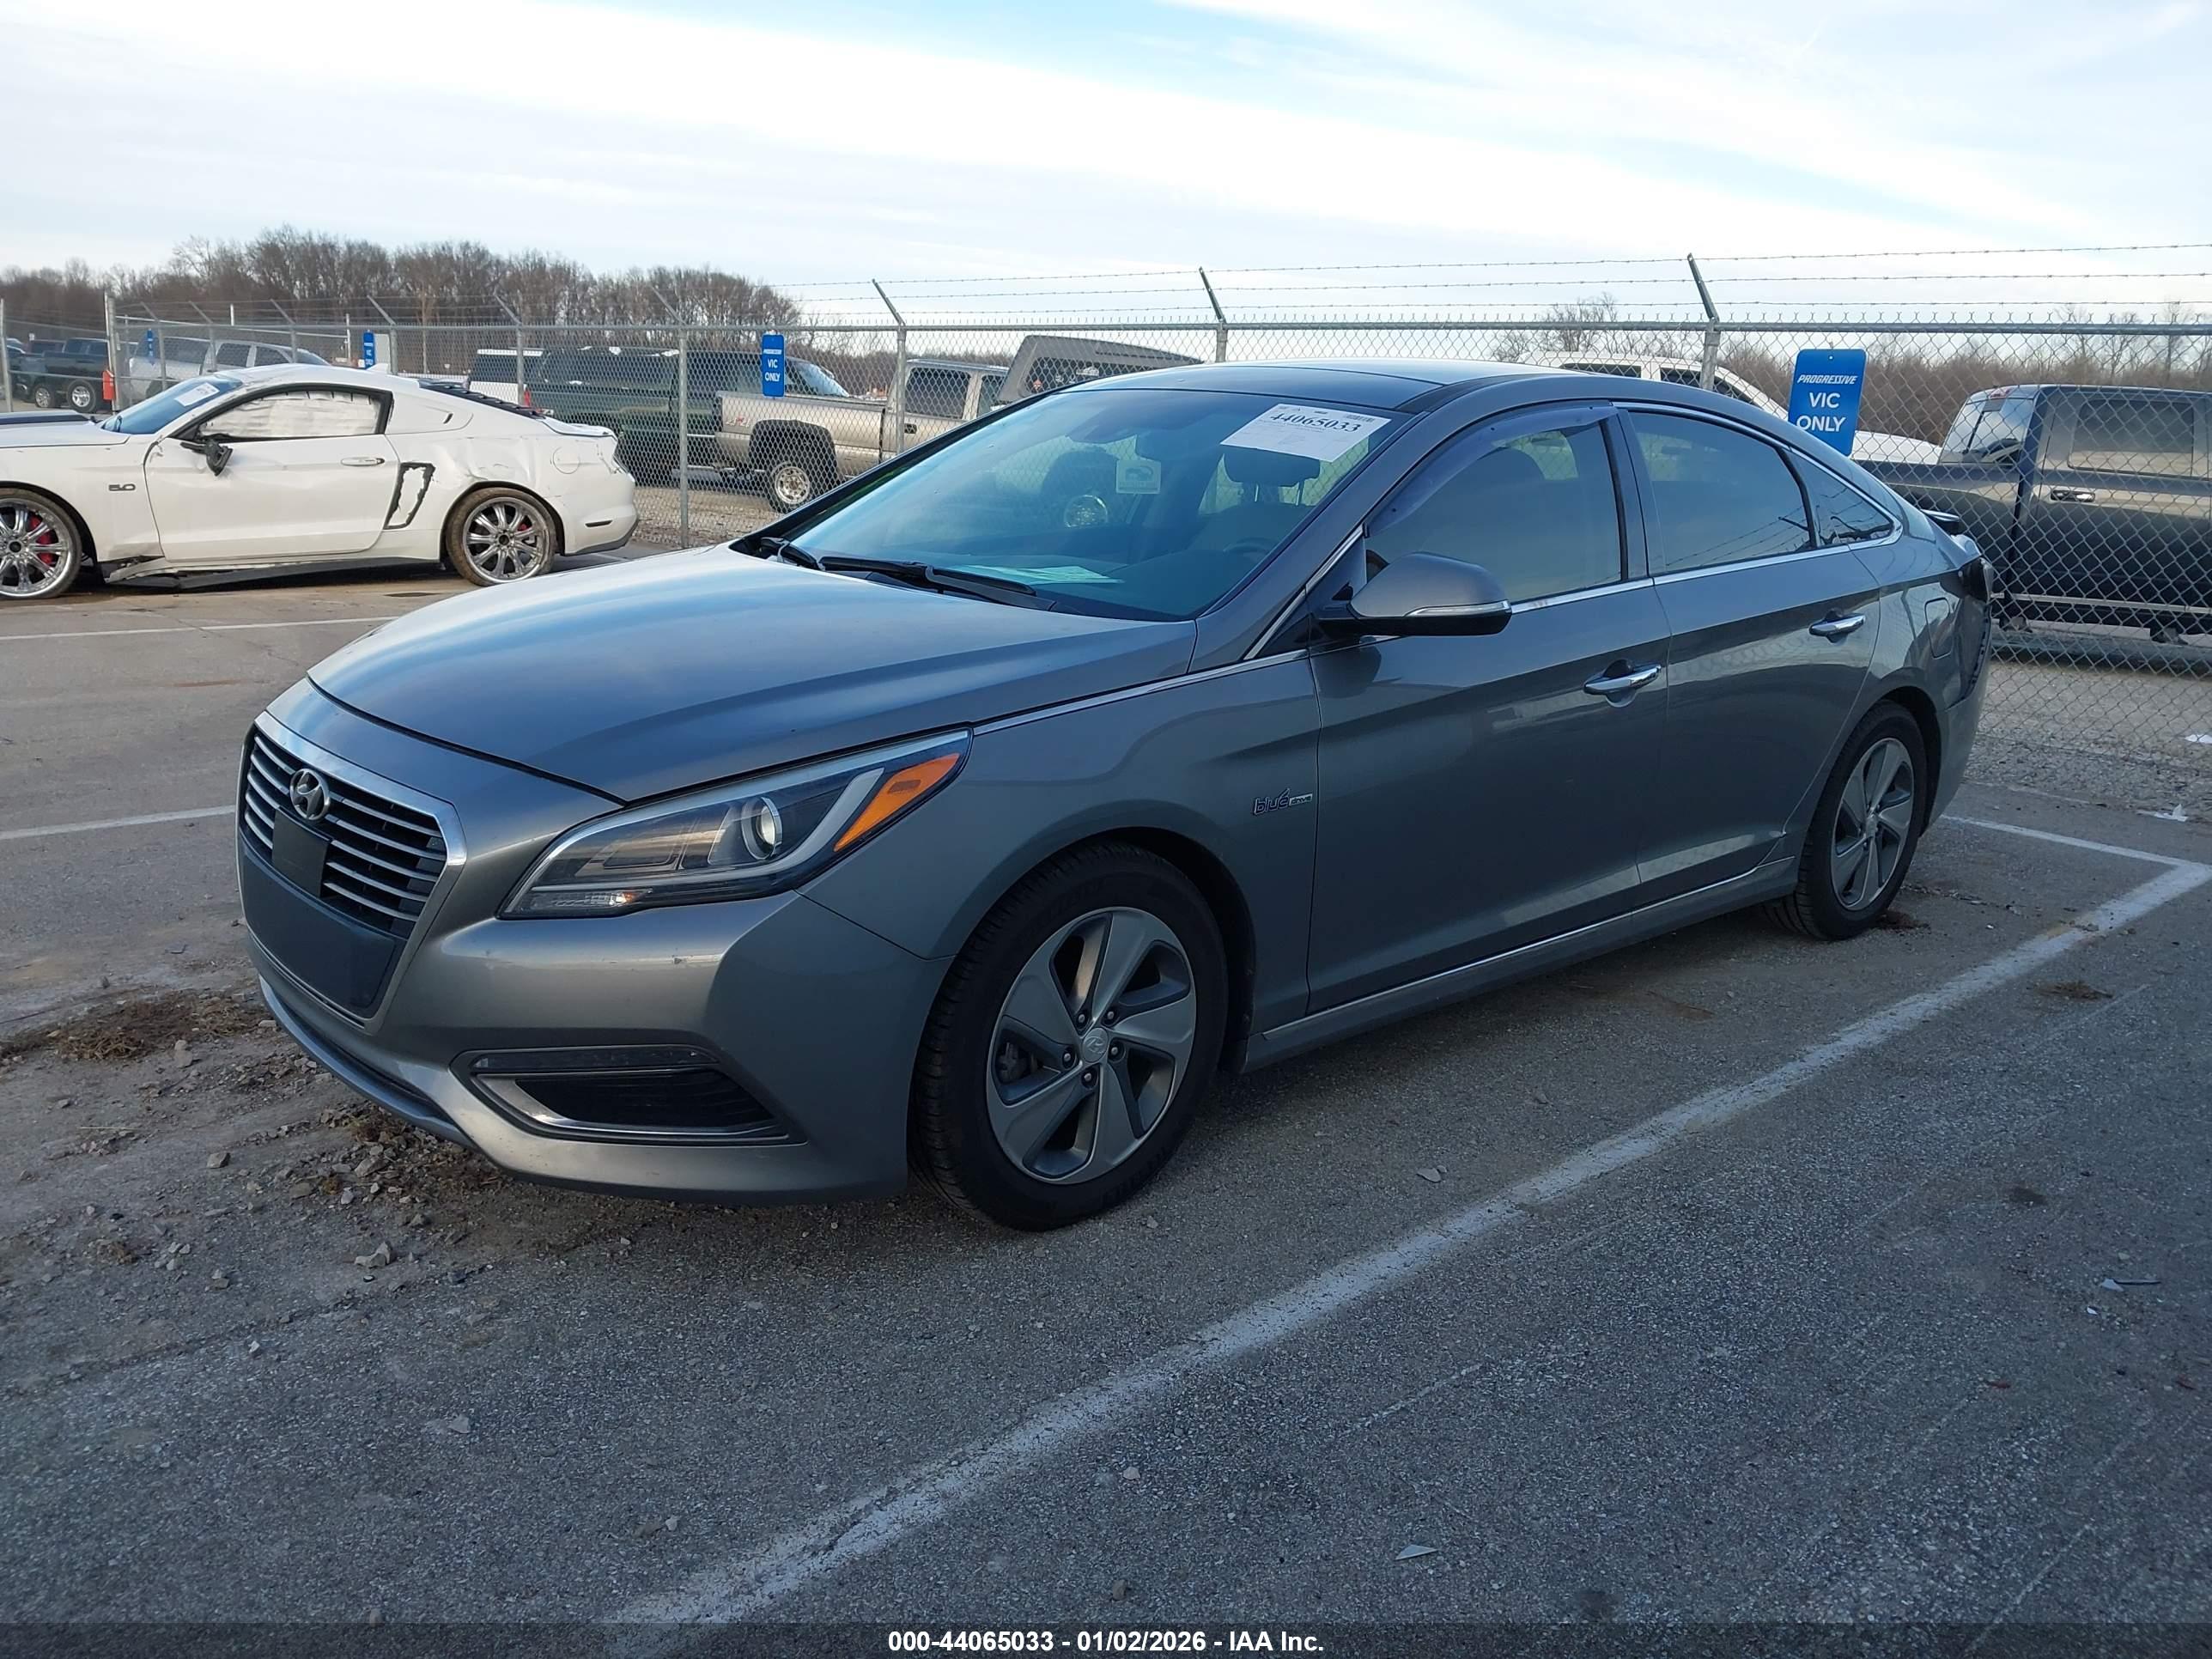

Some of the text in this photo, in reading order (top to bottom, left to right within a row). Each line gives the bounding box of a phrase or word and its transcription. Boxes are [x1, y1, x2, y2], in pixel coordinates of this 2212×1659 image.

[767, 358, 778, 368] VIC
[764, 372, 781, 382] ONLY
[1796, 374, 1858, 385] PROGRESSIVE
[1808, 392, 1841, 409] VIC
[1270, 412, 1363, 433] 44065033
[1796, 415, 1846, 432] ONLY
